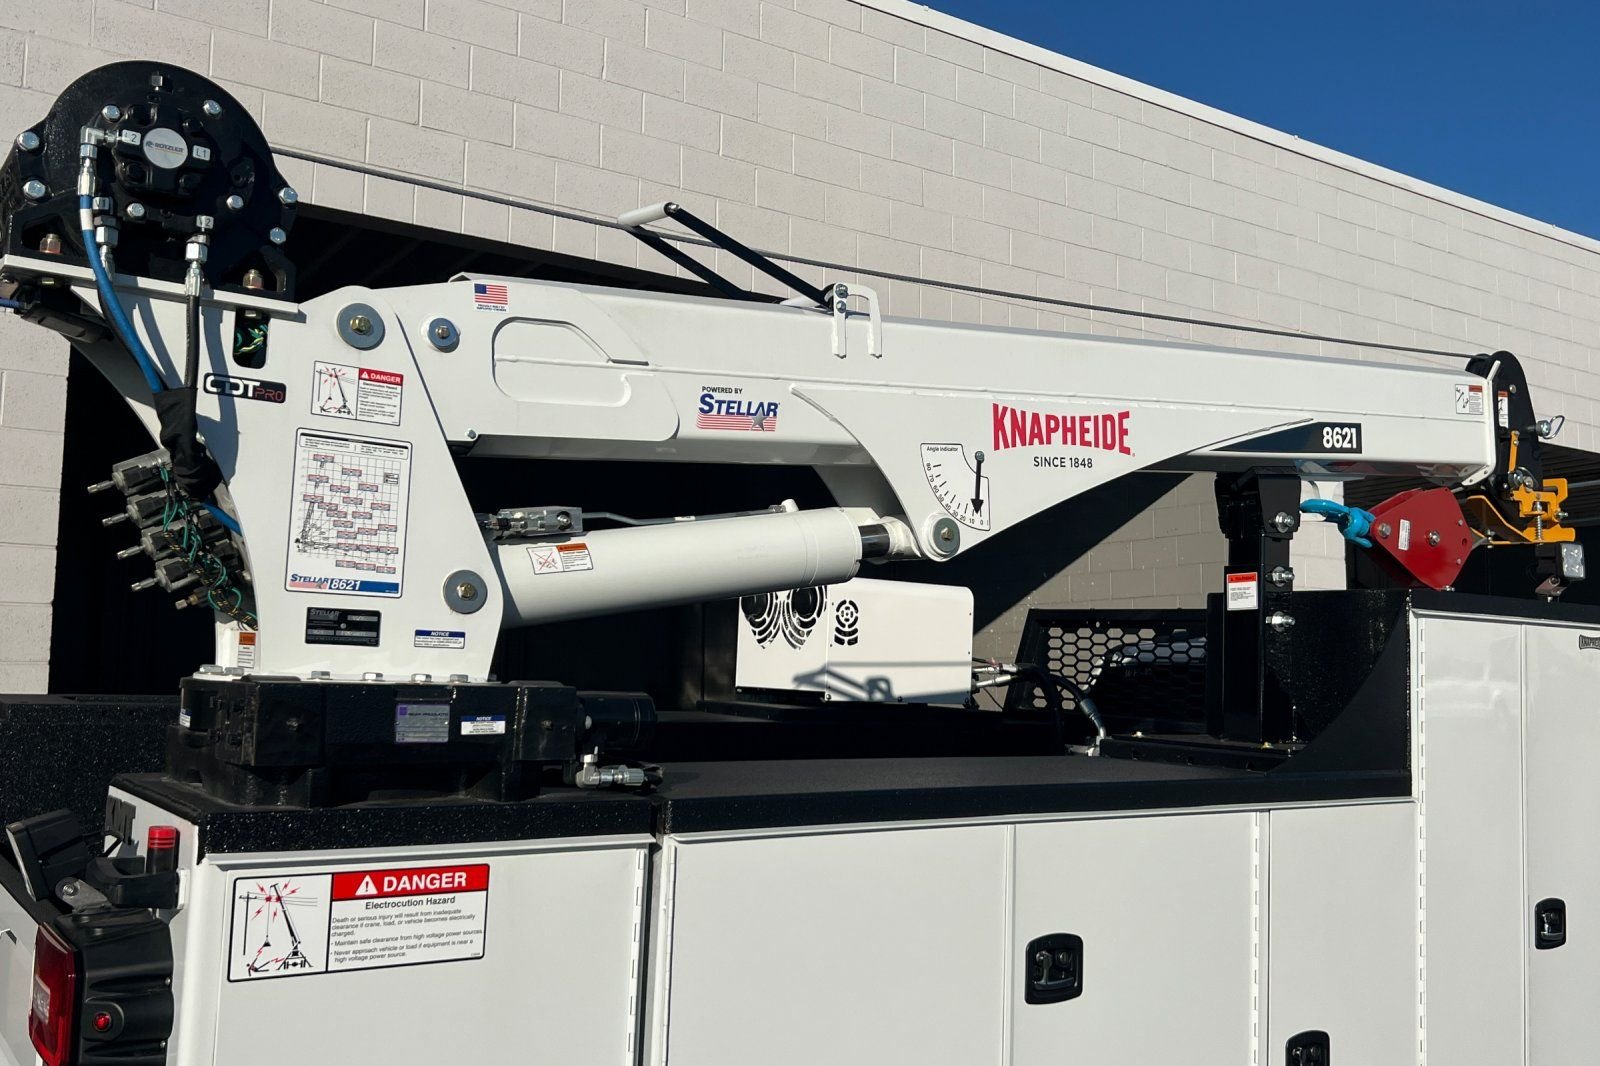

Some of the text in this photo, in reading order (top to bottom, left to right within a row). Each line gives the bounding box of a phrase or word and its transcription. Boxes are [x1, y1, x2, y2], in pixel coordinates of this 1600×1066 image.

[370, 373, 401, 383] DANGER
[702, 386, 733, 394] POWERED
[698, 393, 779, 417] STELLAR
[993, 402, 1131, 456] KNAPHEIDE
[1322, 426, 1357, 449] 8621
[1033, 456, 1093, 469] SINCE 1848
[945, 503, 952, 511] 40
[289, 573, 361, 590] STELLAR 8621
[383, 871, 467, 892] DANGER
[365, 896, 456, 910] Electrocution Hazard
